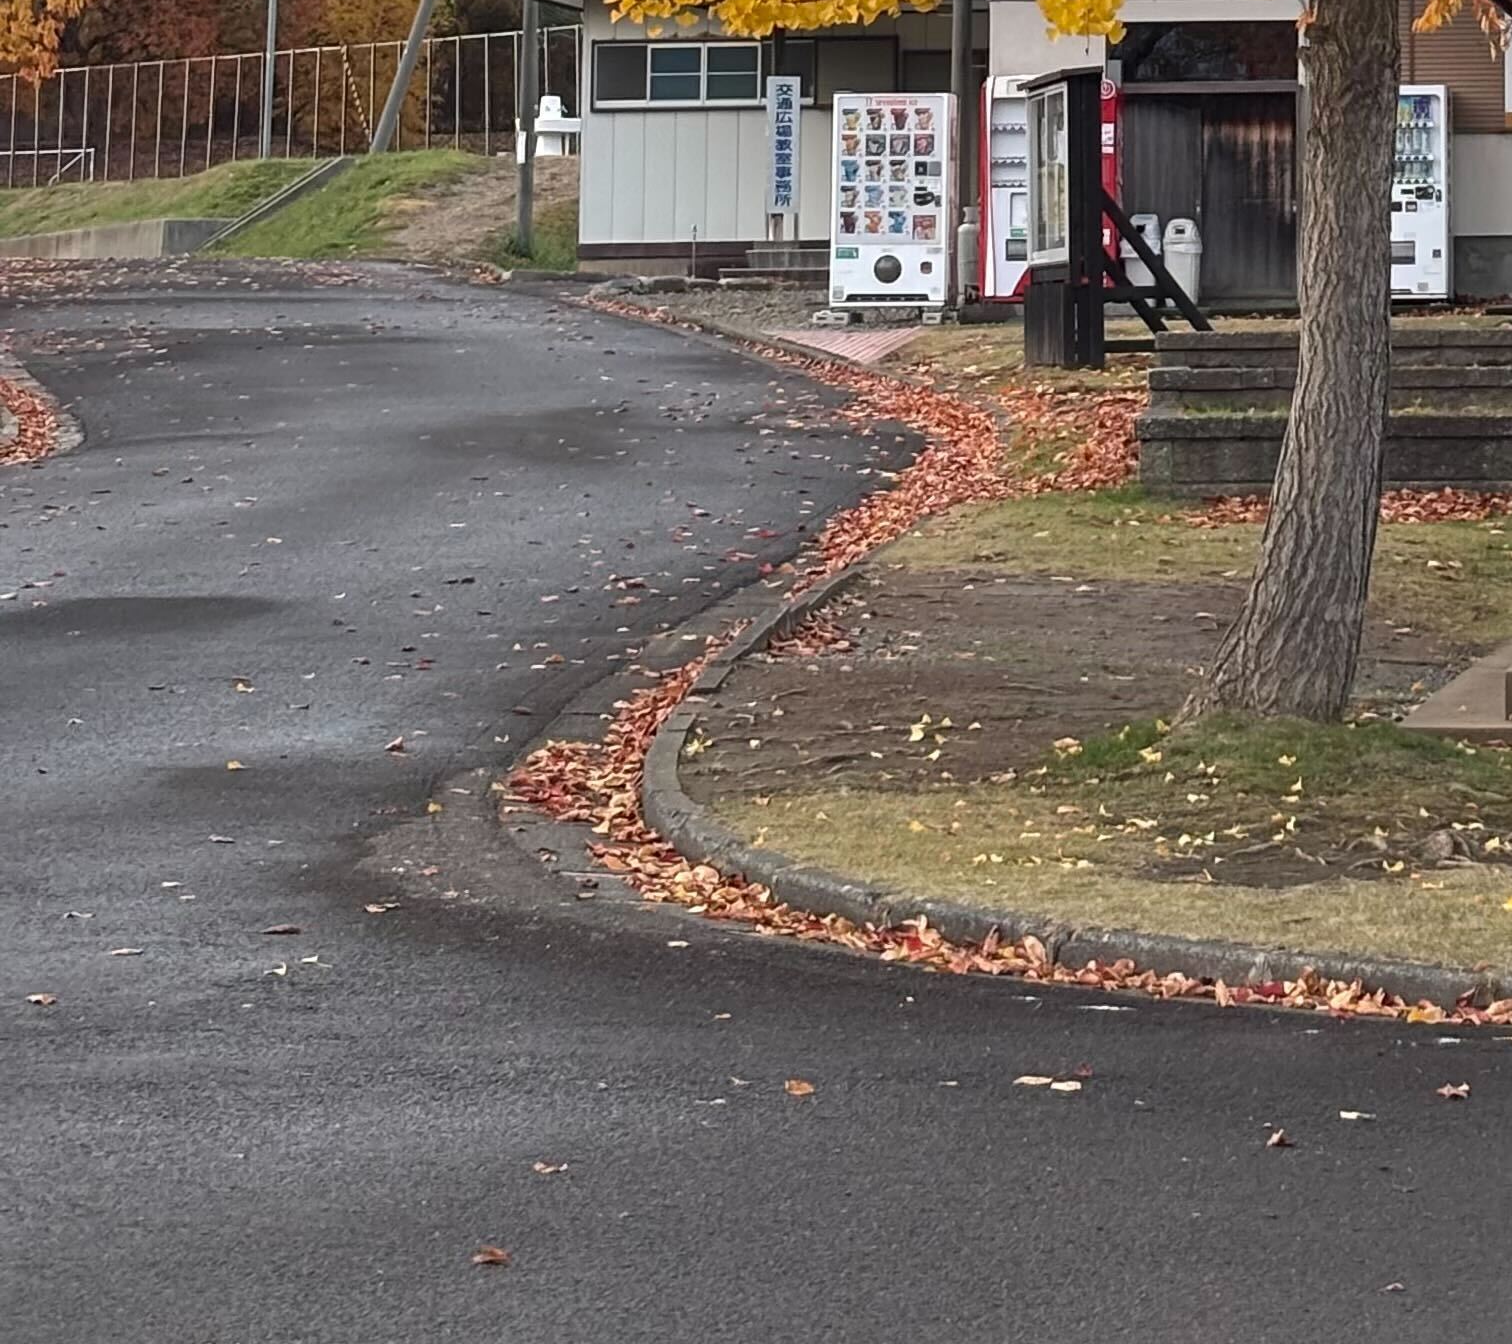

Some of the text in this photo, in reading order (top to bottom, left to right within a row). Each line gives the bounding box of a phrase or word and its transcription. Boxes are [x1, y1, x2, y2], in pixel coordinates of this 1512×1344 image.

[775, 84, 793, 207] 交通広場教室事務所
